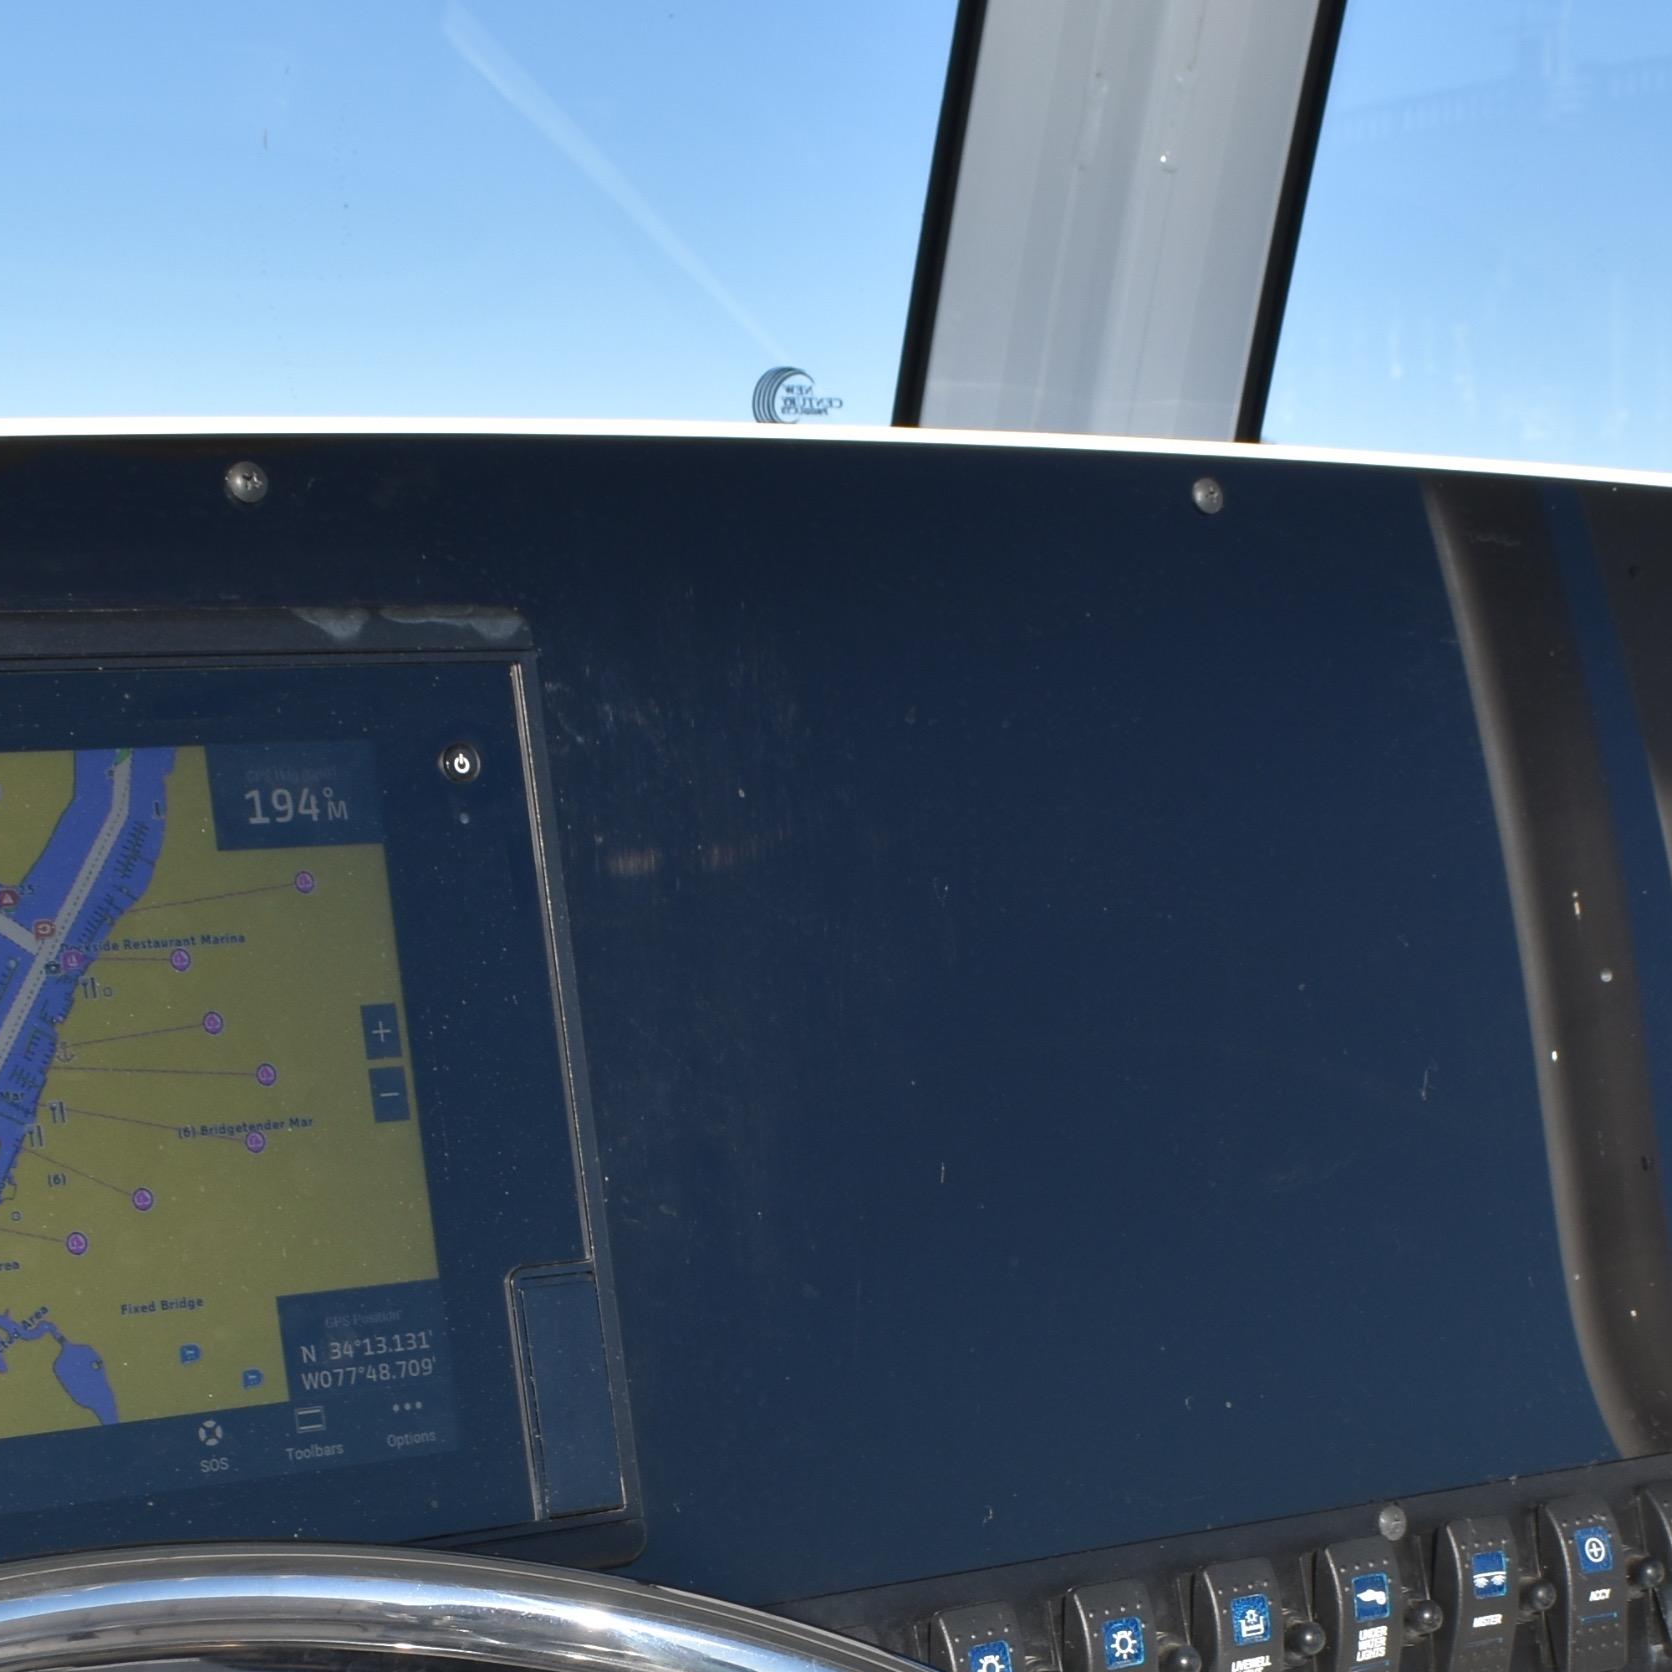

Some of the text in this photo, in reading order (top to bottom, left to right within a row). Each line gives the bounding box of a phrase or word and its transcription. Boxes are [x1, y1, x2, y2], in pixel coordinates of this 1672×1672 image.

[124, 935, 196, 951] Restaurant
[201, 933, 246, 946] Marina
[199, 1118, 285, 1138] Bridgetender
[288, 1115, 314, 1130] Mar
[120, 1296, 205, 1316] Fixed Bridge
[301, 1344, 317, 1364] N
[385, 1431, 438, 1450] Options
[285, 1442, 345, 1463] Toolbars
[199, 1456, 230, 1474] SOS
